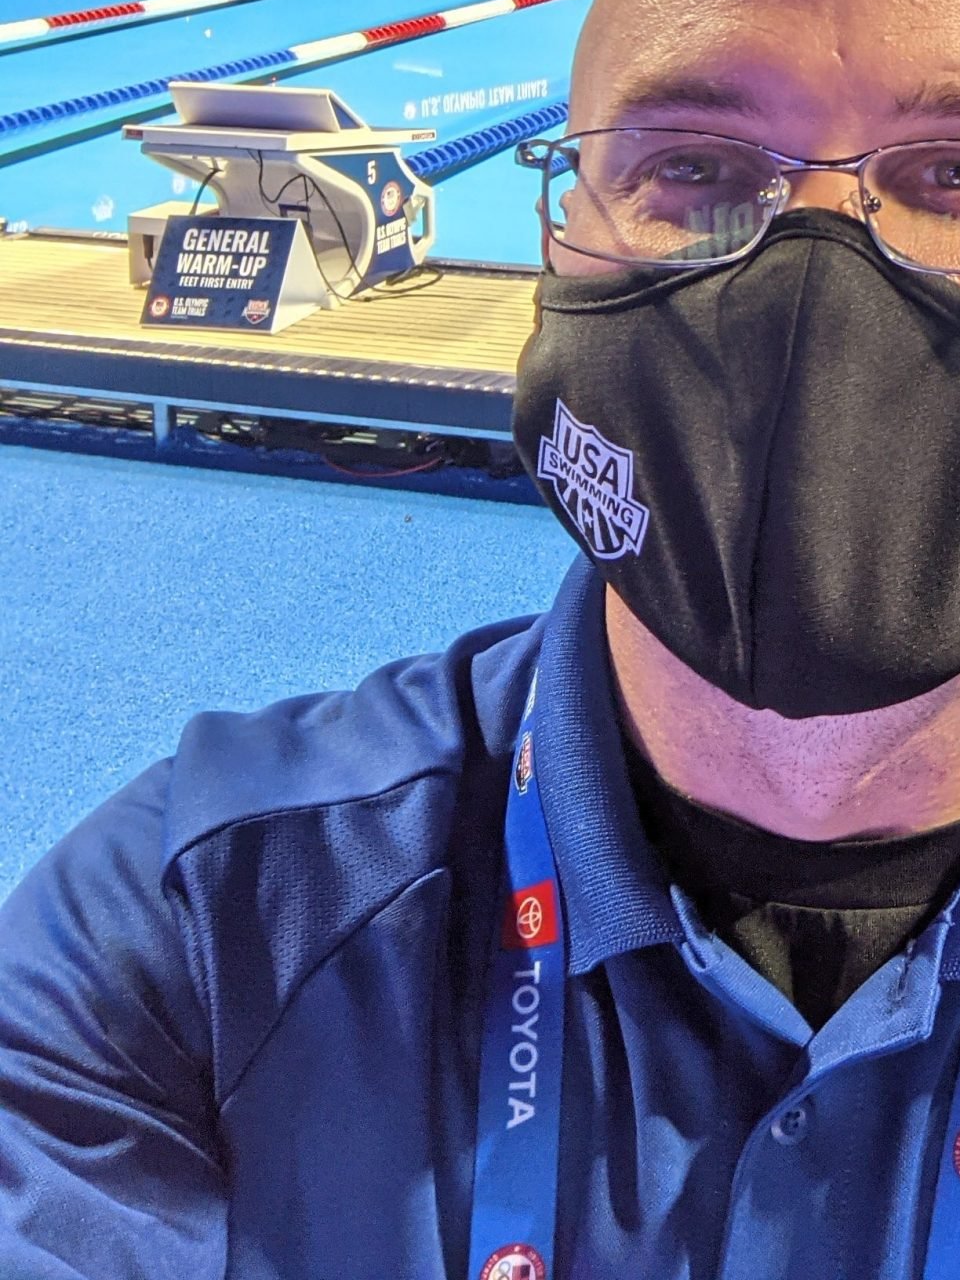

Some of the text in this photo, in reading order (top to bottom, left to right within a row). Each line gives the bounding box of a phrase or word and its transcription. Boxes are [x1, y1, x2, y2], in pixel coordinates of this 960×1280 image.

[367, 160, 377, 185] 5
[182, 228, 270, 255] GENERAL
[176, 253, 267, 278] WARM-UP
[179, 276, 254, 290] FEET FIRST ENTRY
[172, 306, 206, 317] TEAM TRIALS
[185, 297, 209, 308] OLYMPIC
[563, 424, 620, 498] USA
[549, 452, 634, 528] SWIMMING
[506, 960, 541, 1130] TOYOTA
